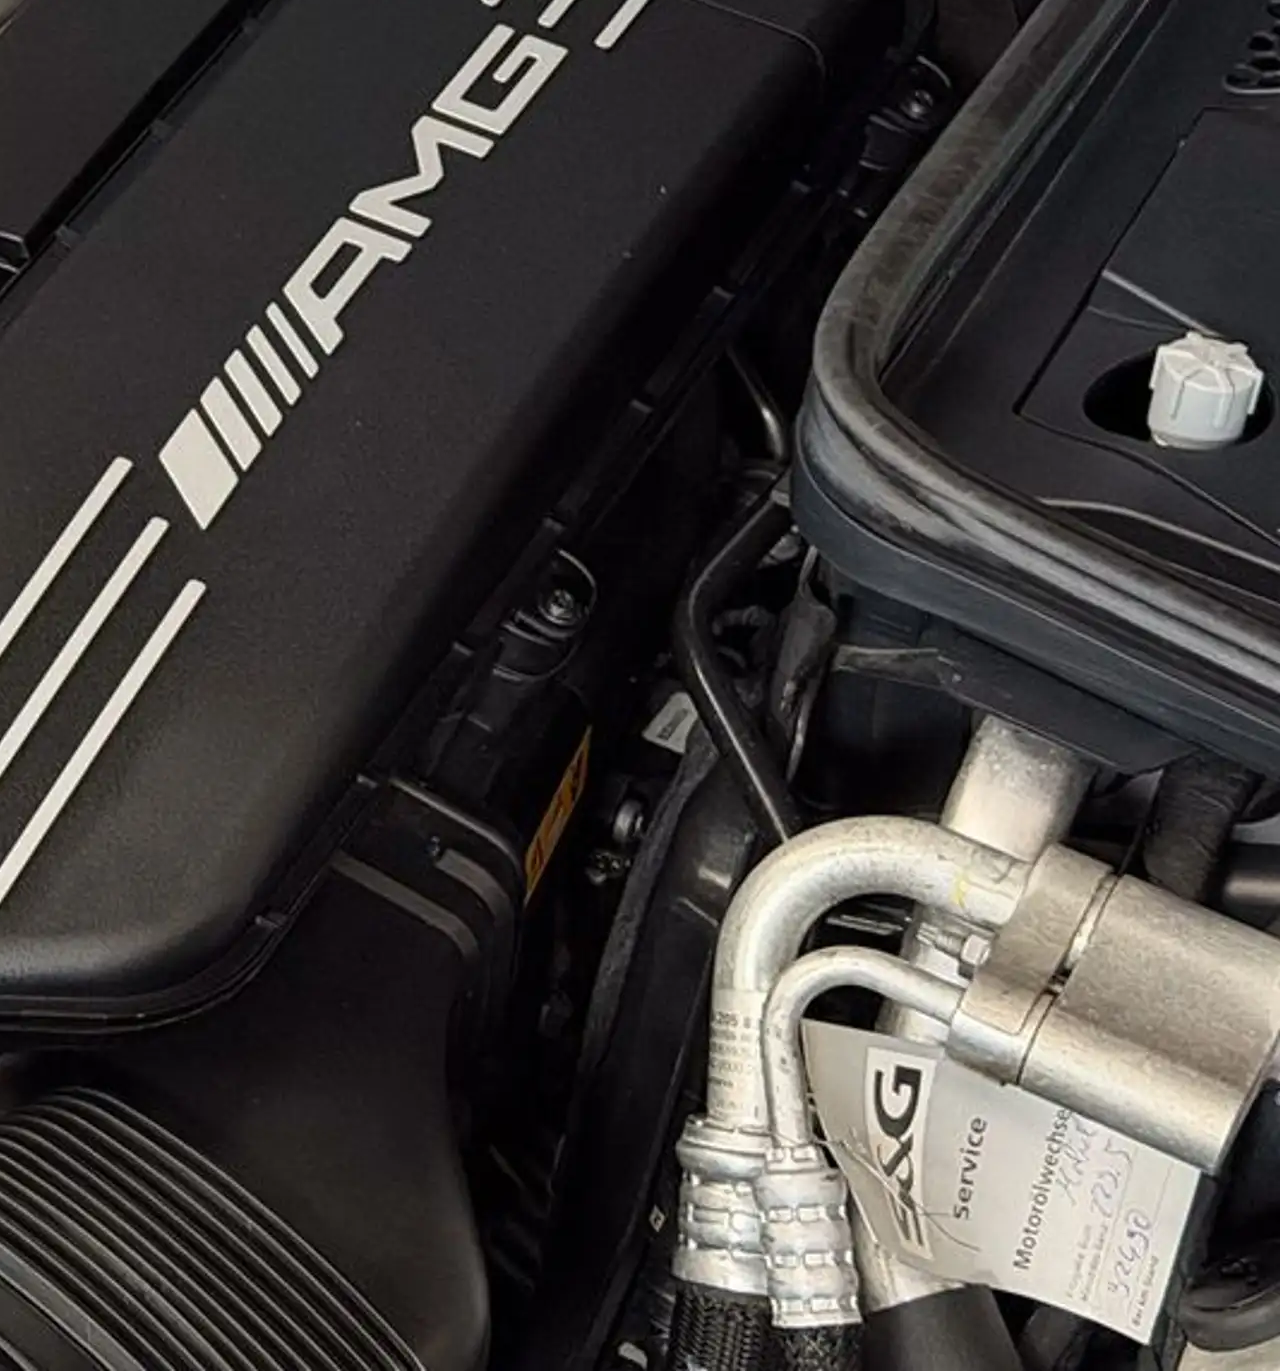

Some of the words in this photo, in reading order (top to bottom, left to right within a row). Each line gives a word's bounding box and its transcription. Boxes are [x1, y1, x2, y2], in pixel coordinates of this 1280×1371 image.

[283, 24, 568, 355] AMG
[953, 1117, 989, 1221] Service
[1013, 1107, 1073, 1271] Motorölwechse
